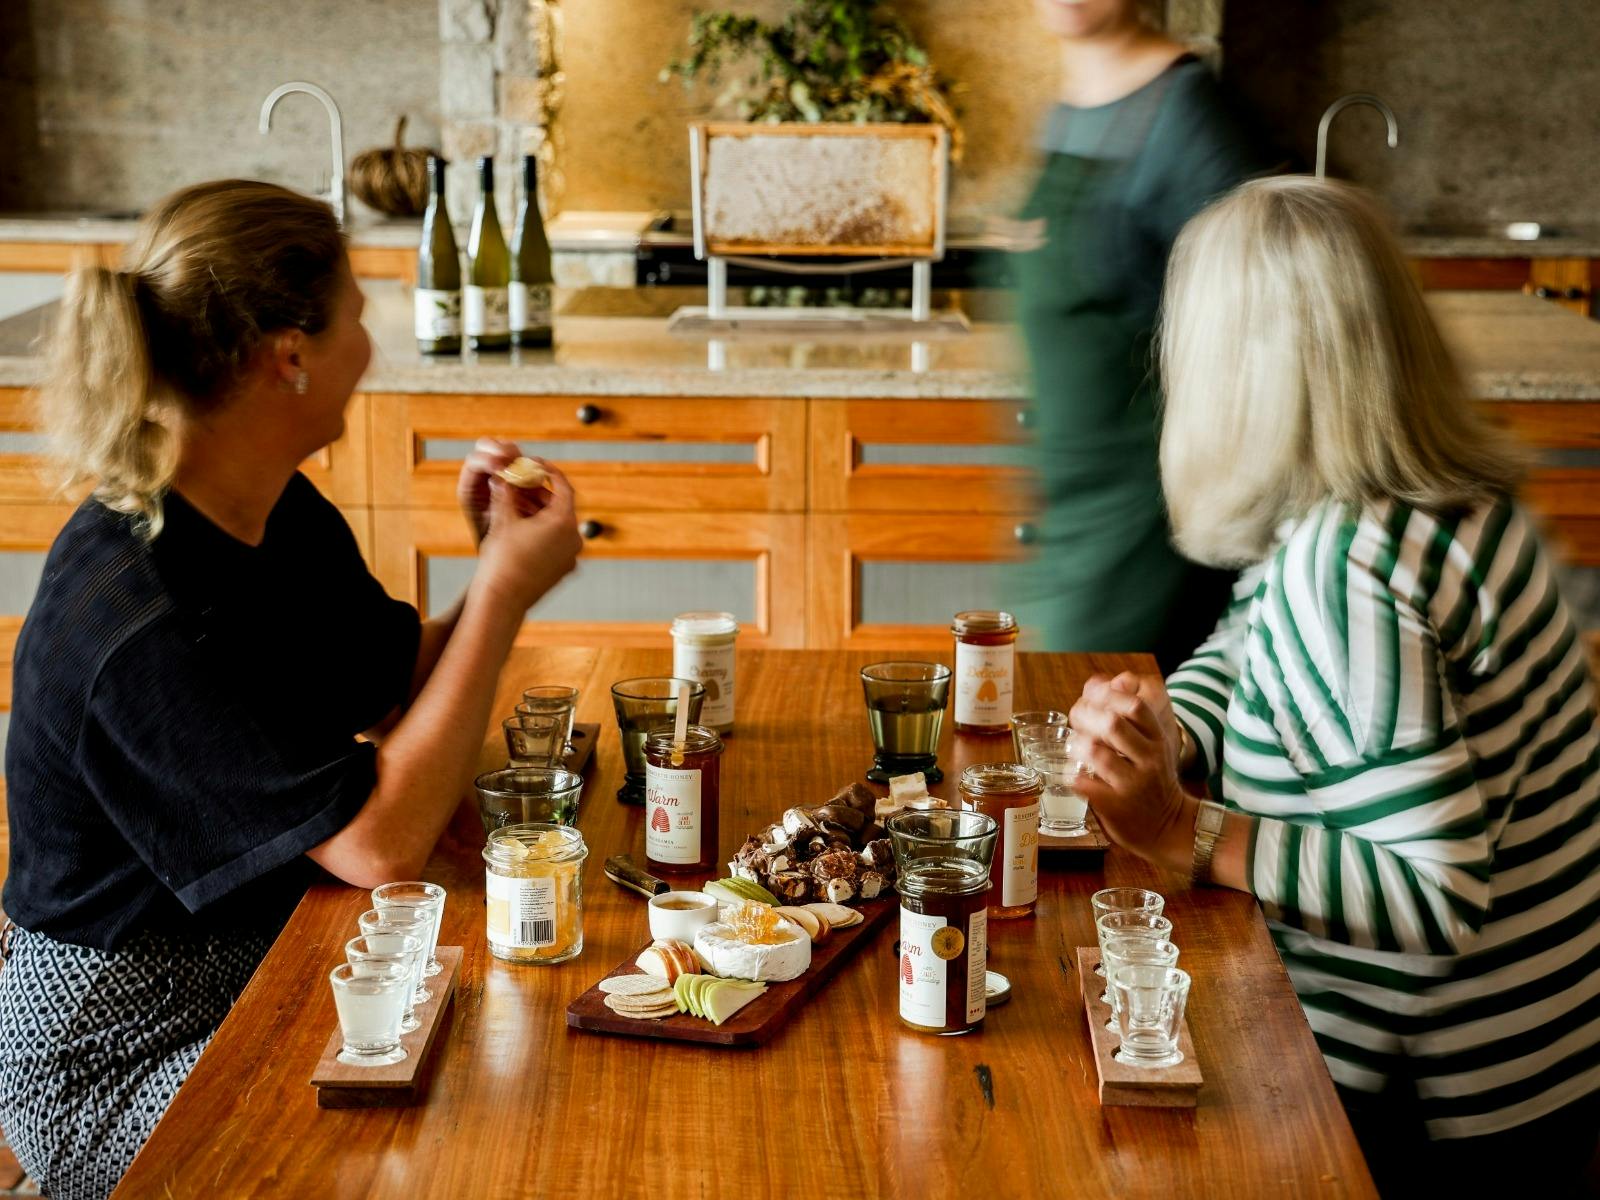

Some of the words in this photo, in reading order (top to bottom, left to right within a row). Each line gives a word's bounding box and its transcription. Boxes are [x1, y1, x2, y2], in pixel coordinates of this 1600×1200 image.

[689, 665, 727, 680] Creamy
[966, 667, 1008, 678] Delicate
[647, 788, 680, 807] Warm
[900, 938, 923, 957] arm
